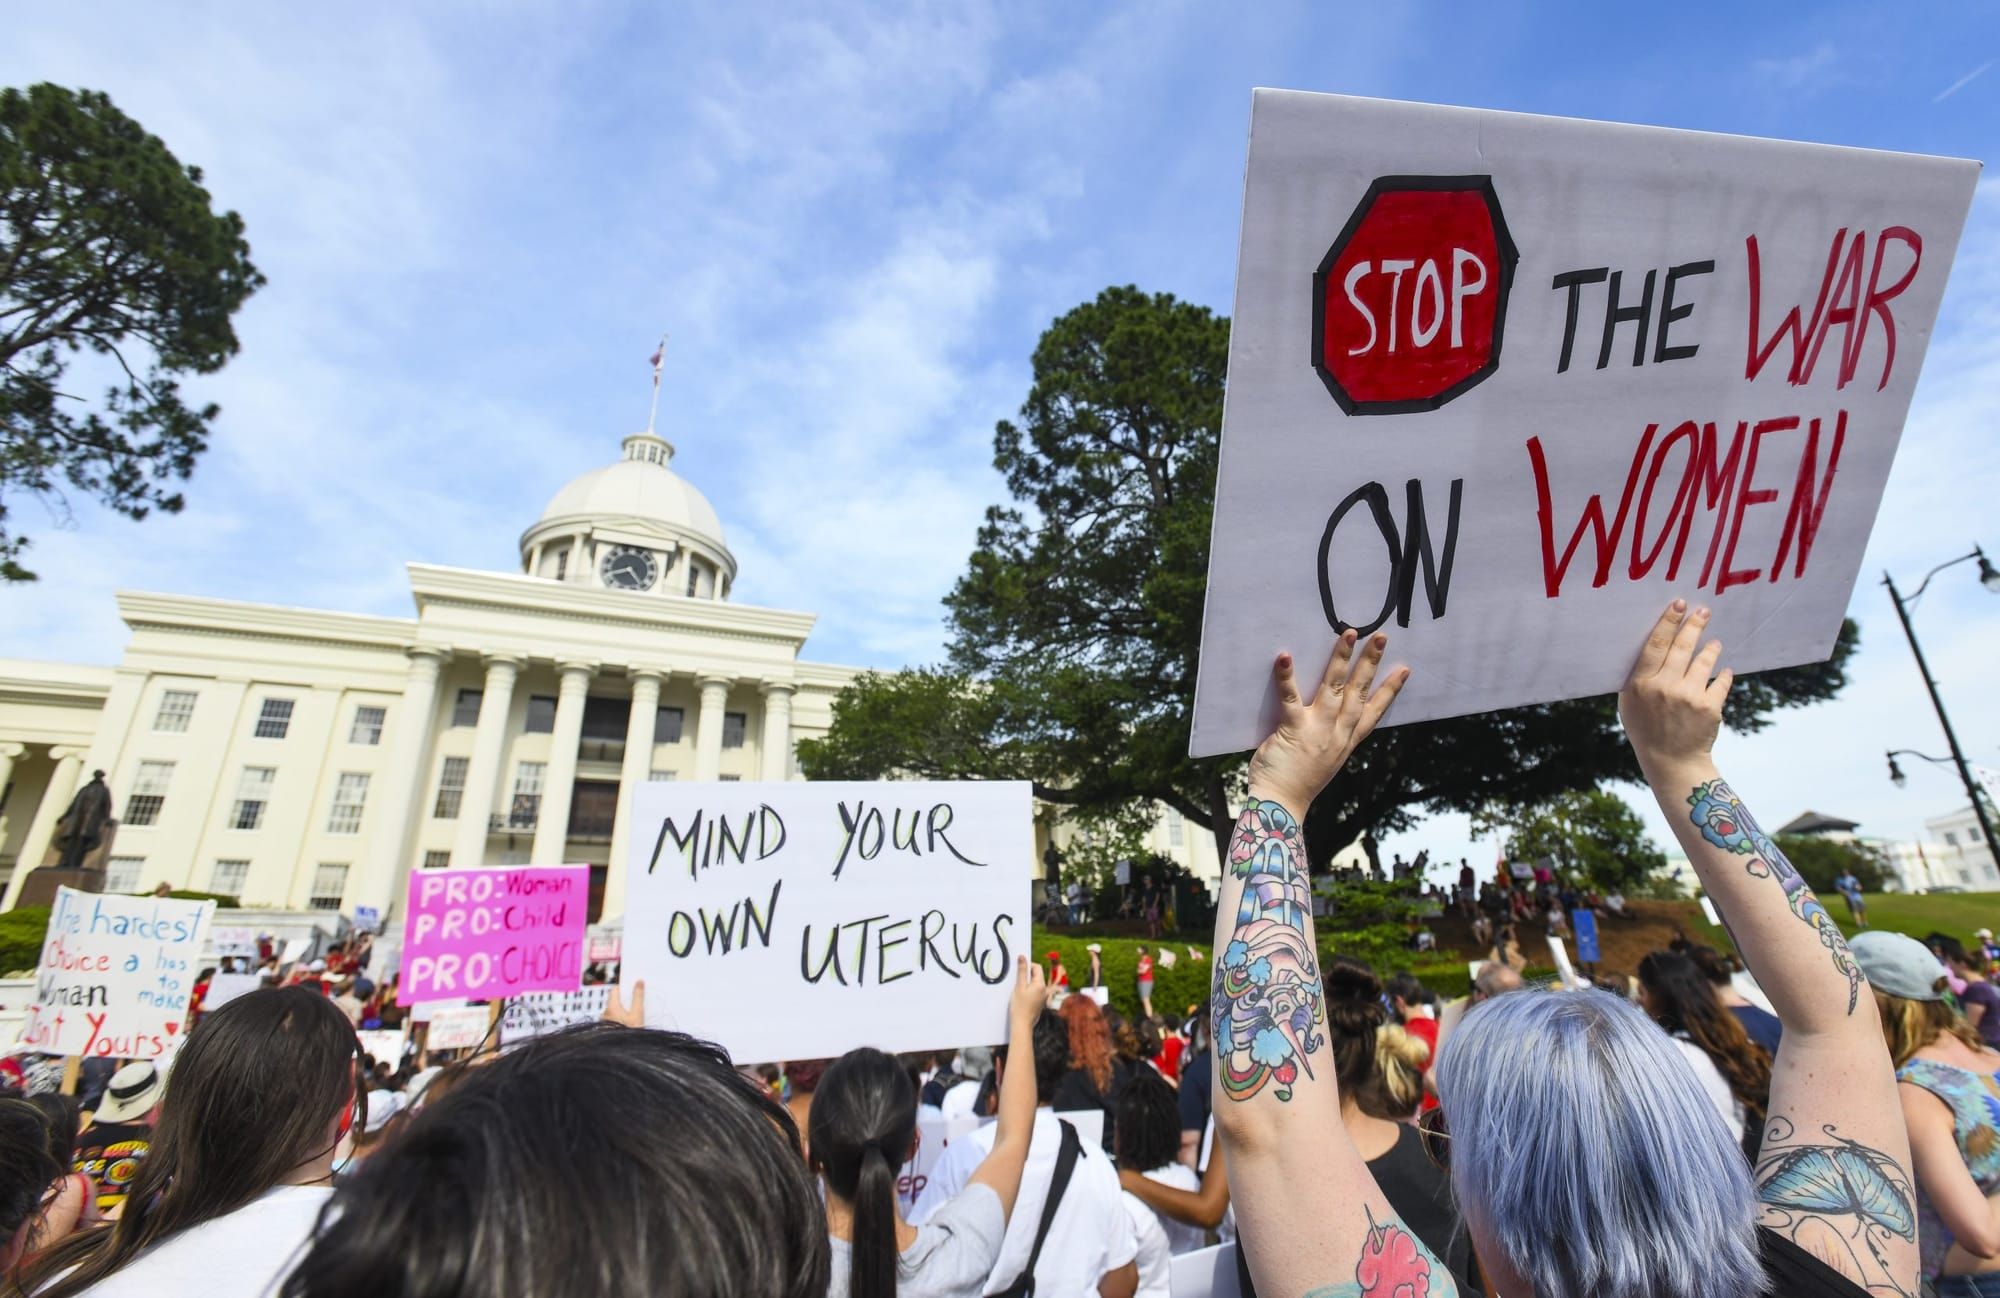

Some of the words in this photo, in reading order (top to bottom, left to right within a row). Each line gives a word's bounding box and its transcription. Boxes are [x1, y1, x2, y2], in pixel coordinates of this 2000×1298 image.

[1344, 248, 1486, 357] STOP
[1553, 260, 1715, 373] THE
[1746, 226, 1923, 392] WAR
[1318, 479, 1463, 637] ON
[1527, 410, 1848, 598] WOMEN
[648, 803, 787, 881] MIND
[832, 800, 988, 881] YOUR
[420, 875, 505, 909] PRO:
[506, 872, 572, 896] Woman
[90, 898, 203, 942] hardest
[414, 907, 503, 945] PRO:
[504, 903, 566, 932] Child
[668, 879, 782, 958] OWN
[801, 910, 1013, 987] UTERUS
[124, 953, 139, 972] a
[156, 946, 187, 971] has
[158, 974, 179, 991] to
[408, 952, 500, 994] PRO:
[502, 942, 580, 985] CHOICE
[138, 991, 186, 1010] make
